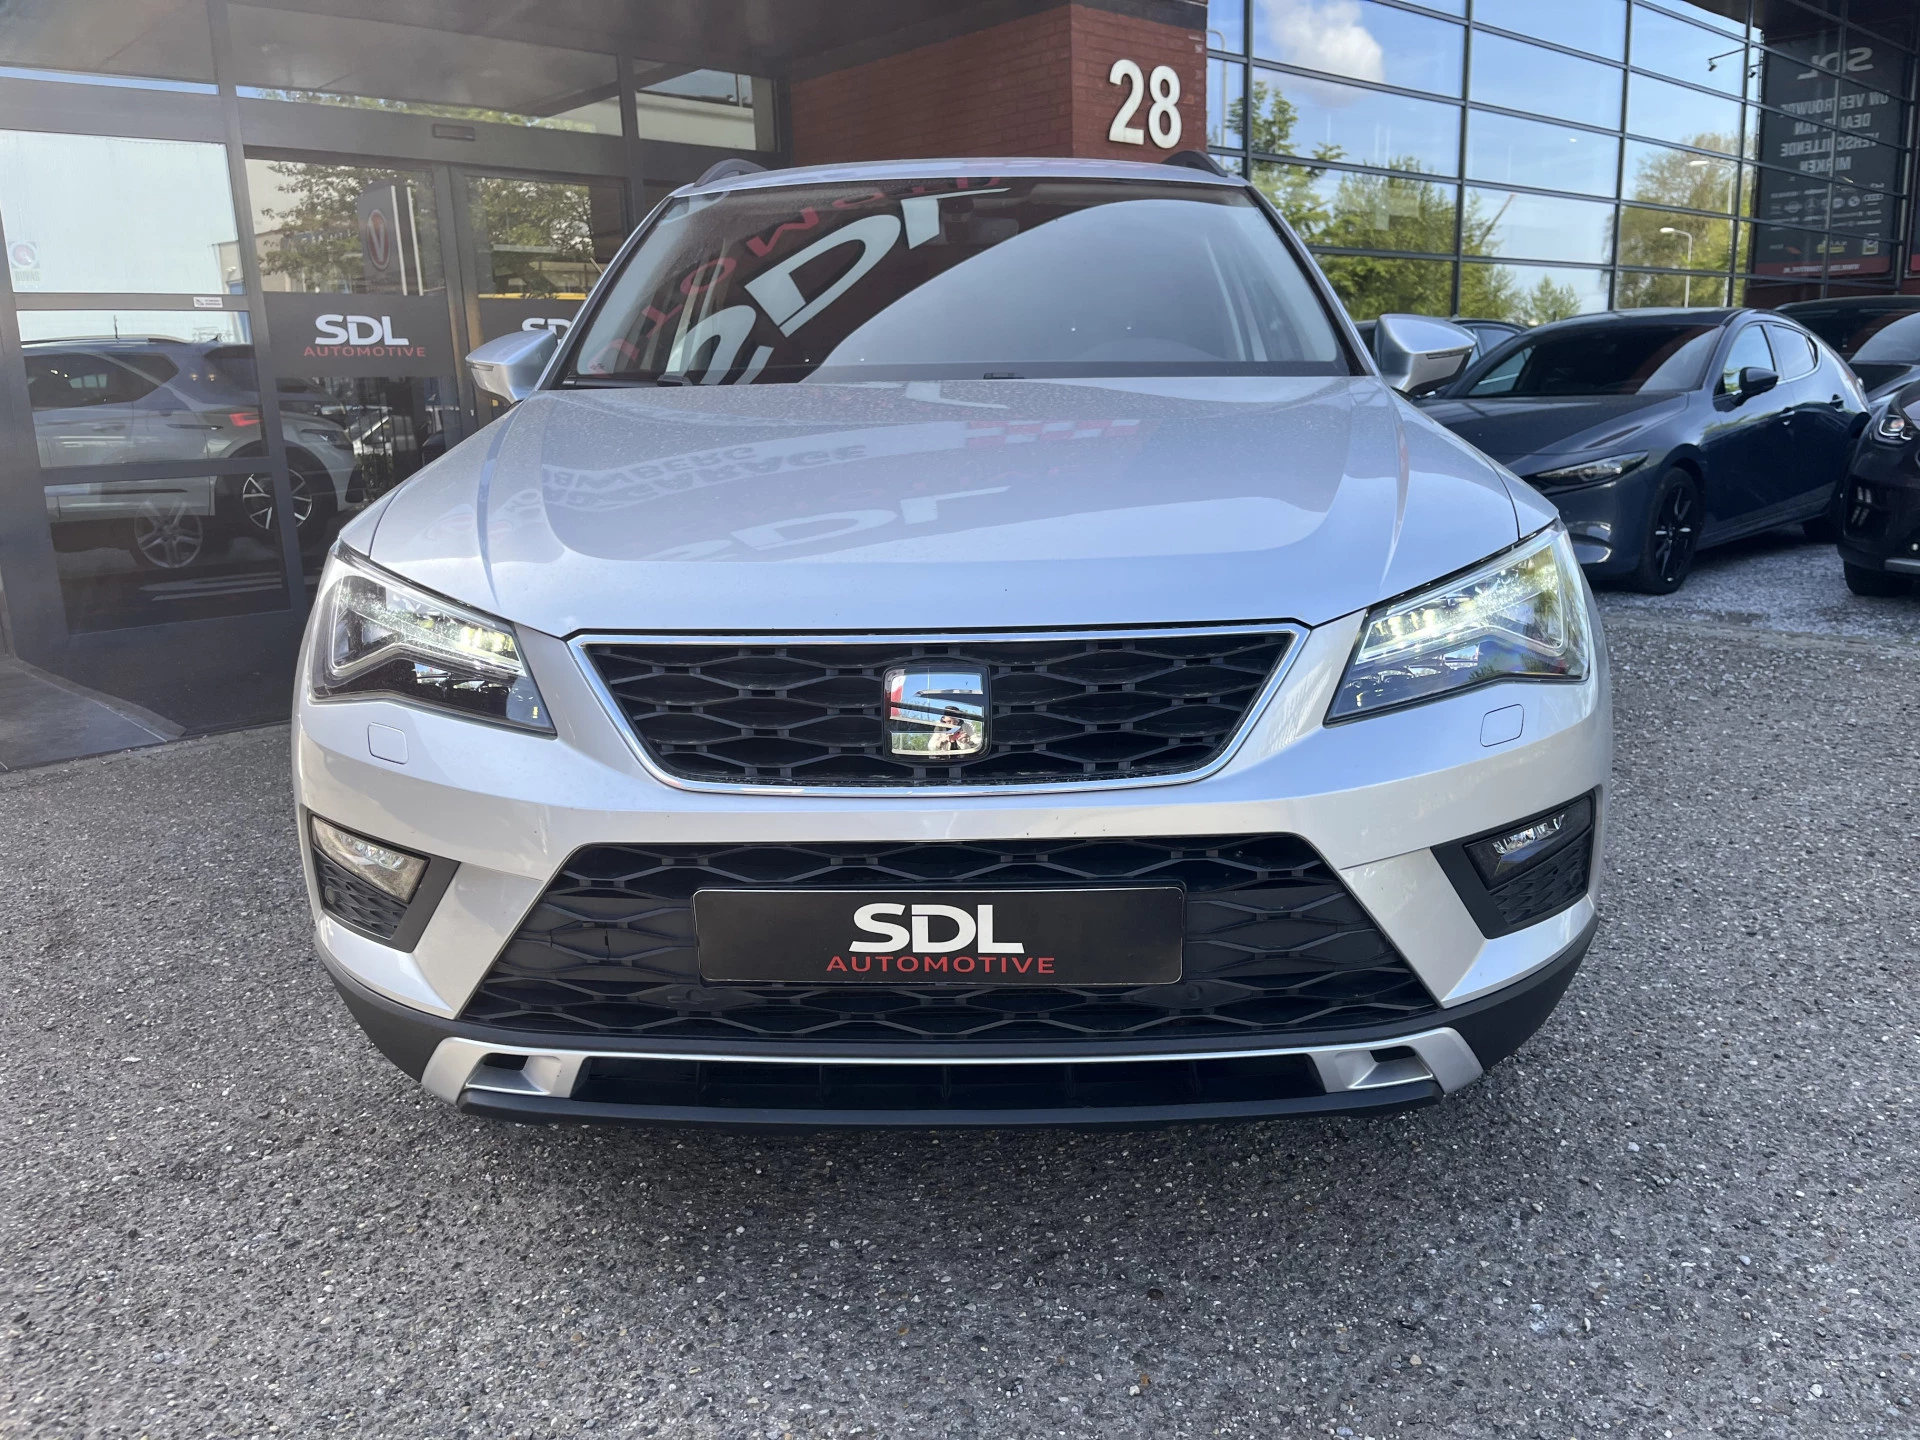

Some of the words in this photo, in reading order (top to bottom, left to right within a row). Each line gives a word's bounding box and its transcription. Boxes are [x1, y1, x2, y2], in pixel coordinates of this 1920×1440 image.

[1108, 59, 1182, 149] 28
[315, 314, 409, 345] SDL
[304, 346, 426, 357] AUTOMOTIVE
[848, 903, 1025, 953] SDL
[826, 955, 1055, 974] AUTOMOTIVE
